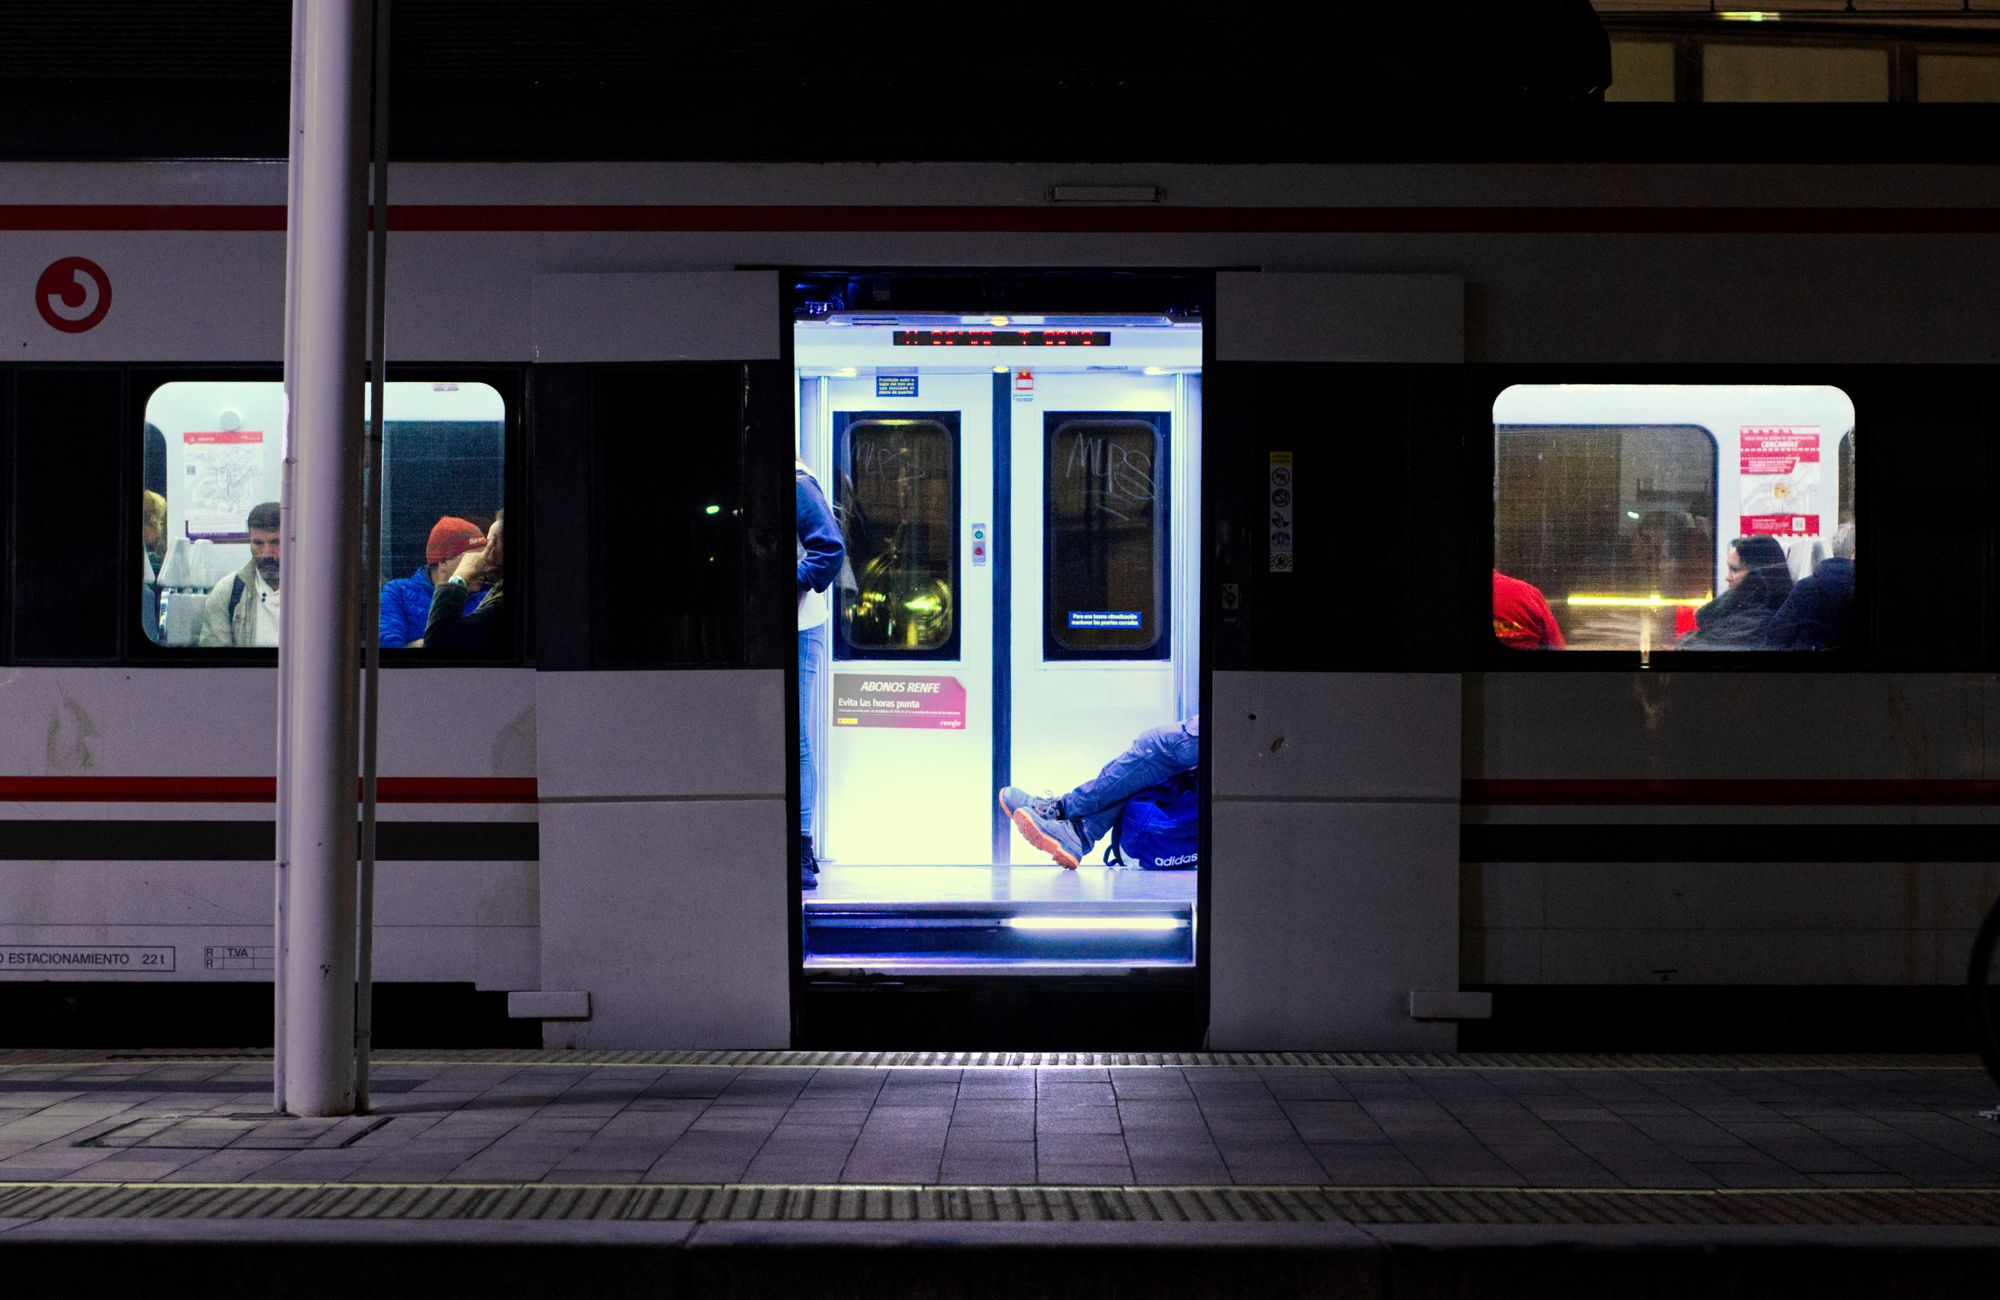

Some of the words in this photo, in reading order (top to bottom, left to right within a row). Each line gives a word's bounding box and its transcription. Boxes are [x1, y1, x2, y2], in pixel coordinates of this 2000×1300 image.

[860, 681, 906, 692] ABONOS
[907, 682, 941, 693] RENFE
[838, 698, 858, 706] Evita
[860, 698, 872, 707] las
[873, 698, 895, 707] horas
[896, 700, 920, 709] punta
[940, 719, 961, 728] renfe
[1154, 852, 1198, 867] adidas
[206, 948, 213, 956] R
[8, 953, 130, 964] ESTACIONAMIENTO
[206, 959, 213, 968] R
